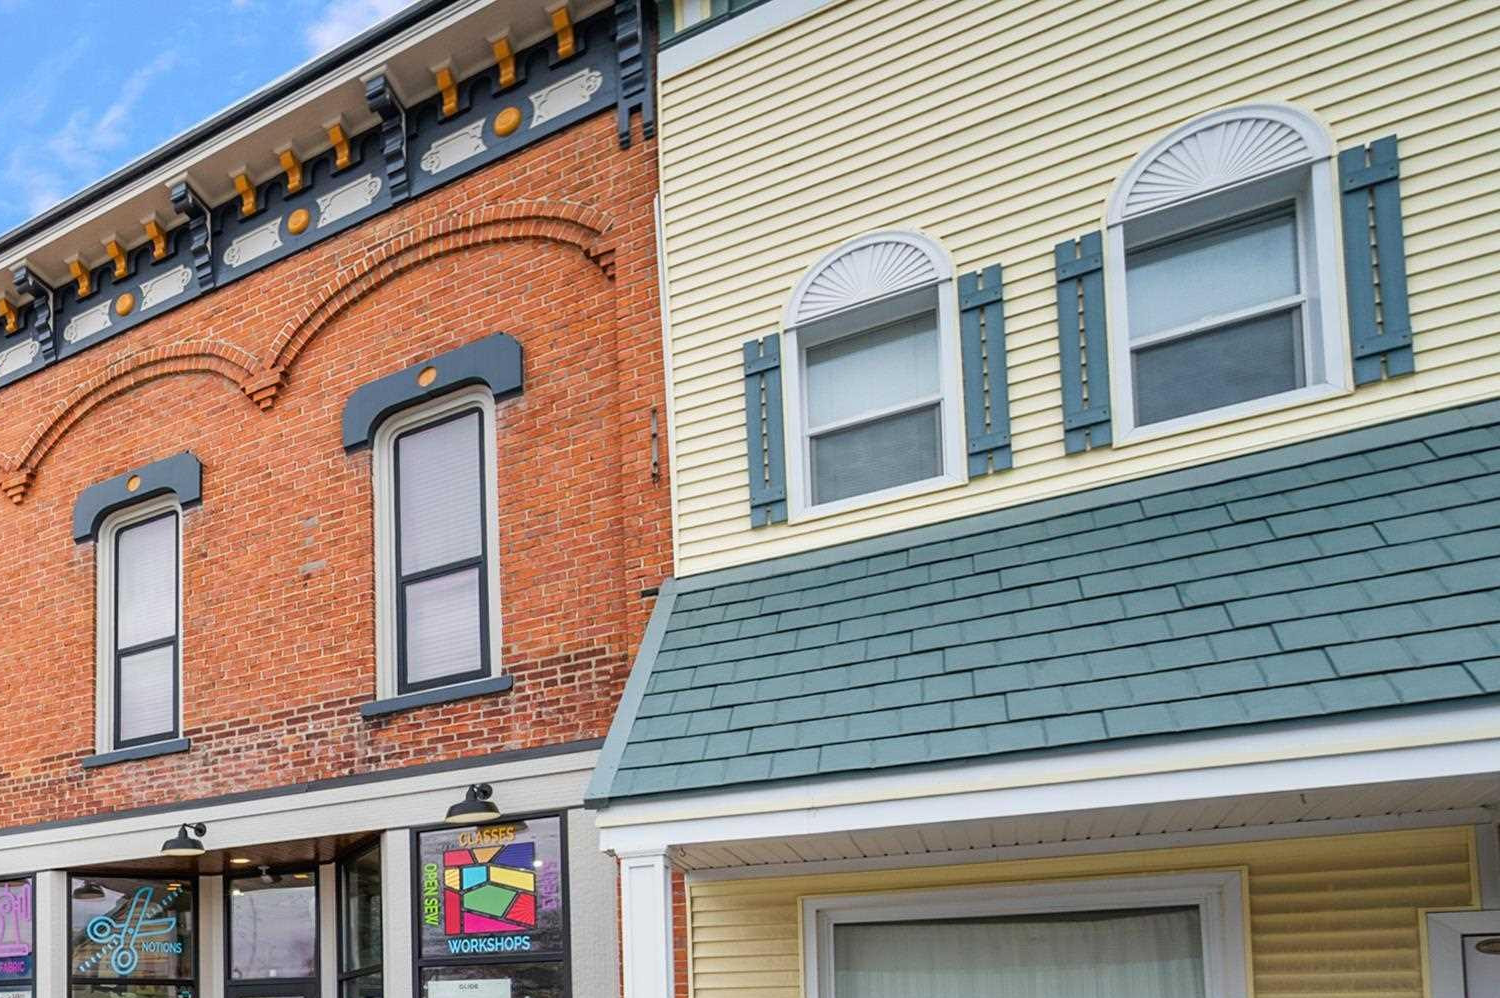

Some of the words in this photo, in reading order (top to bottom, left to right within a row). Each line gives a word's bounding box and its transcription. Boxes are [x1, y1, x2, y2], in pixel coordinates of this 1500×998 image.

[458, 826, 516, 846] CLASSES
[424, 863, 438, 896] OPEN
[424, 897, 439, 926] SEW
[141, 942, 182, 954] NOTIONS
[448, 935, 531, 954] WORKSHOPS
